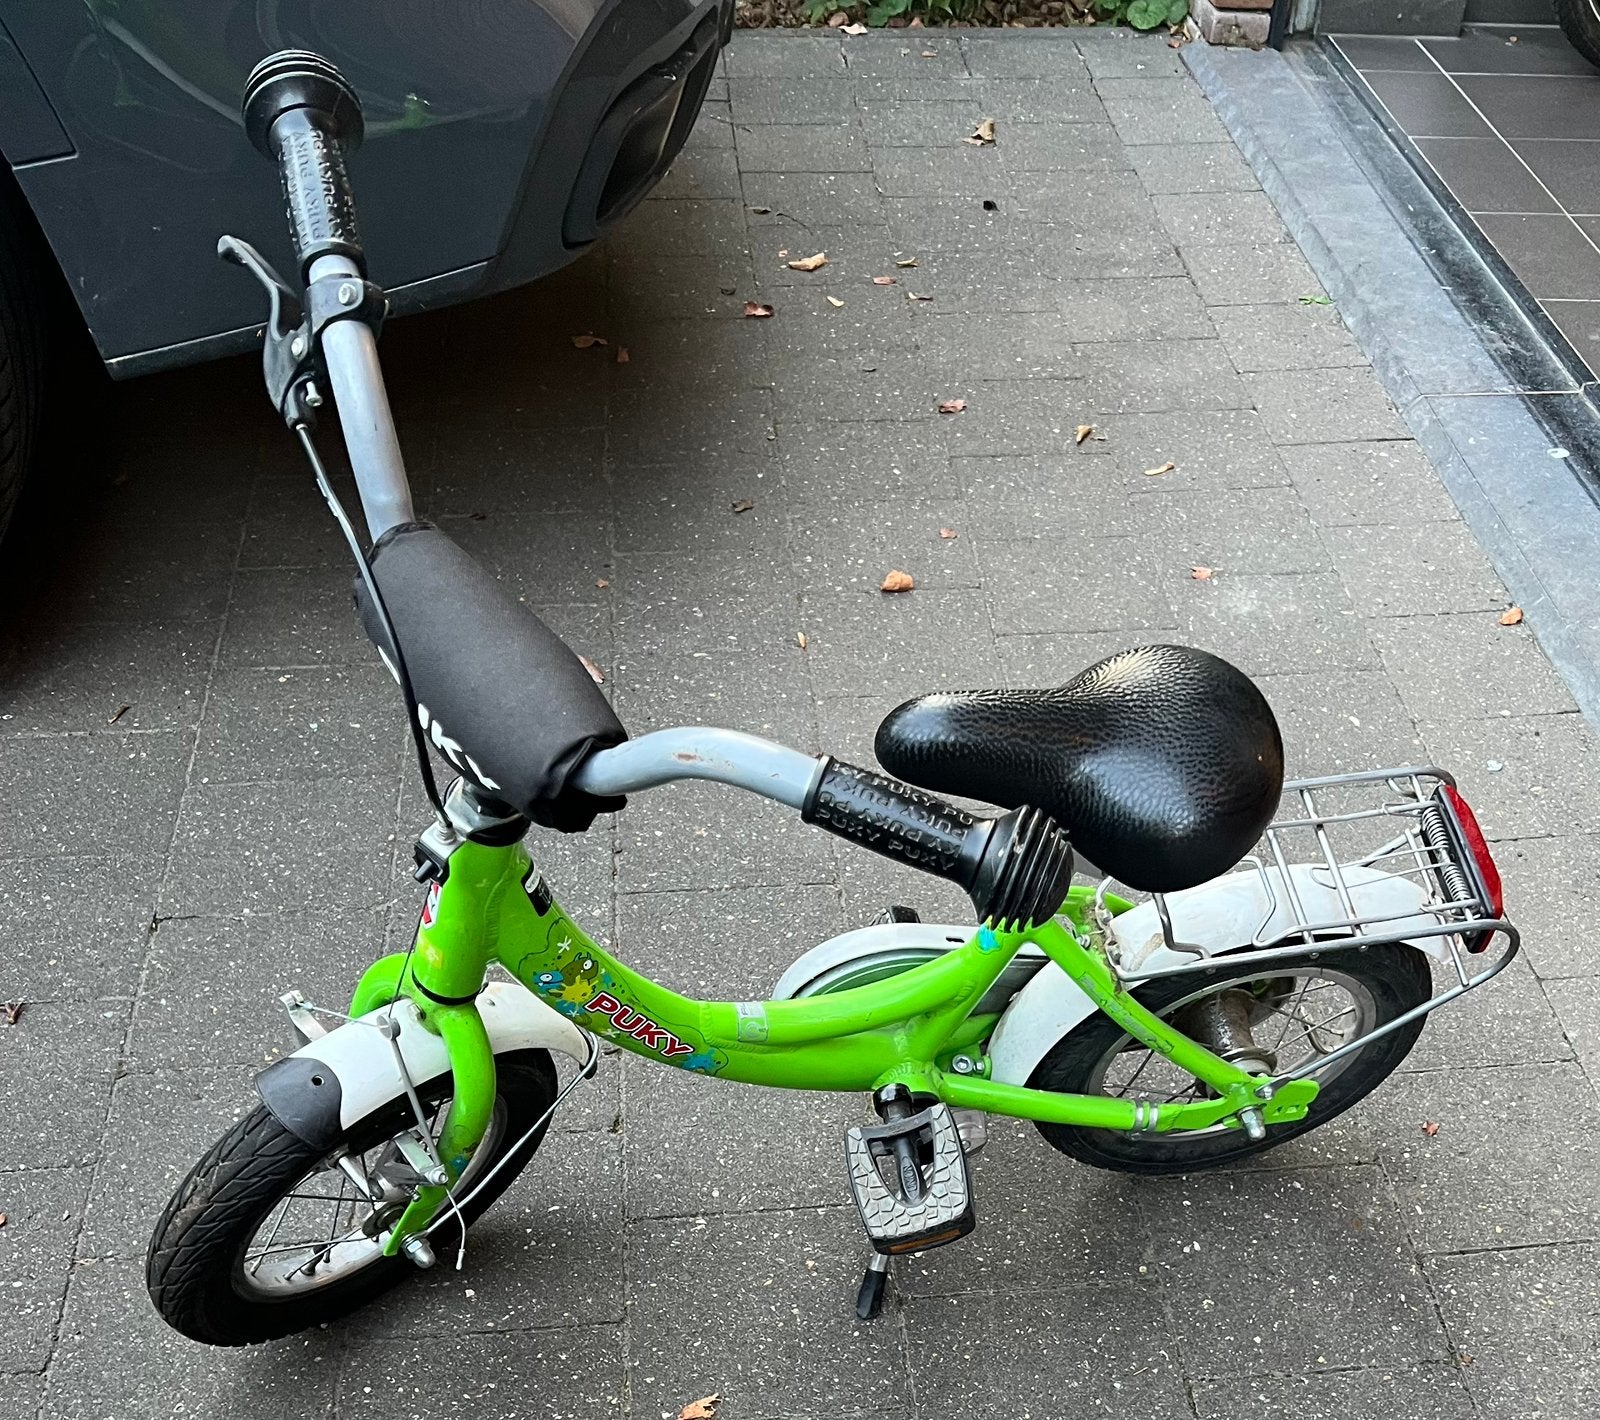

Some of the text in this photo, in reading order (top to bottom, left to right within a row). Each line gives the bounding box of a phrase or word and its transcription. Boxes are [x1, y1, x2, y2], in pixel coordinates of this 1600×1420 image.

[824, 776, 970, 843] PUKY PUKY
[857, 807, 924, 844] PUKY
[872, 776, 937, 808] PUKY
[942, 805, 974, 827] PU
[814, 807, 957, 873] PUKY PUKY
[584, 991, 694, 1057] PUKY
